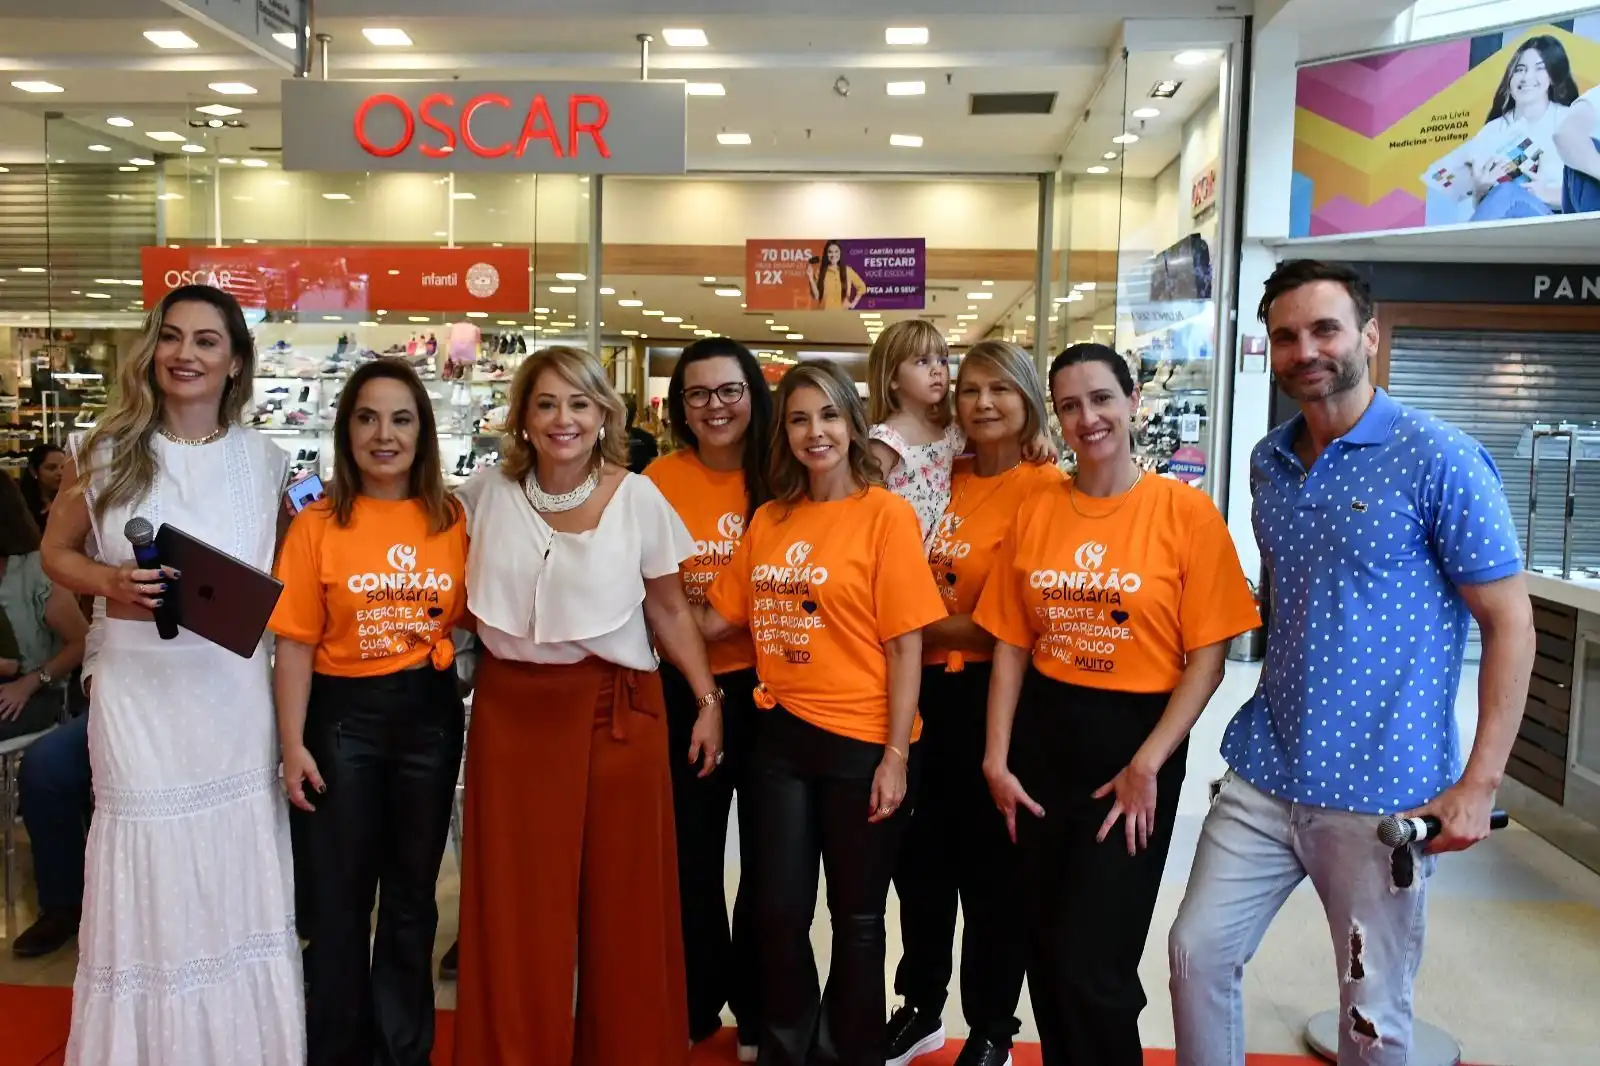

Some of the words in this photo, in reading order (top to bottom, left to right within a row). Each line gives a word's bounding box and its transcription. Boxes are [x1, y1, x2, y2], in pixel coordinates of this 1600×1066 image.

[354, 93, 611, 158] OSCAR
[1419, 121, 1469, 135] APROVADA
[1389, 138, 1427, 149] Medicina
[1434, 132, 1469, 142] Unifesp
[761, 248, 778, 262] 70
[780, 248, 813, 262] DIAS
[864, 256, 916, 268] FESTCARD
[164, 270, 233, 290] OSCAR
[421, 271, 458, 287] infantil
[754, 270, 784, 285] 12X
[1170, 464, 1188, 472] AQUI
[347, 568, 453, 593] CONEXÃO
[1029, 568, 1142, 593] CONEXÃO
[1042, 581, 1122, 606] solidária
[356, 606, 413, 621] EXERCITE
[415, 606, 425, 618] A
[1096, 608, 1105, 622] A
[1075, 655, 1115, 671] MUITO
